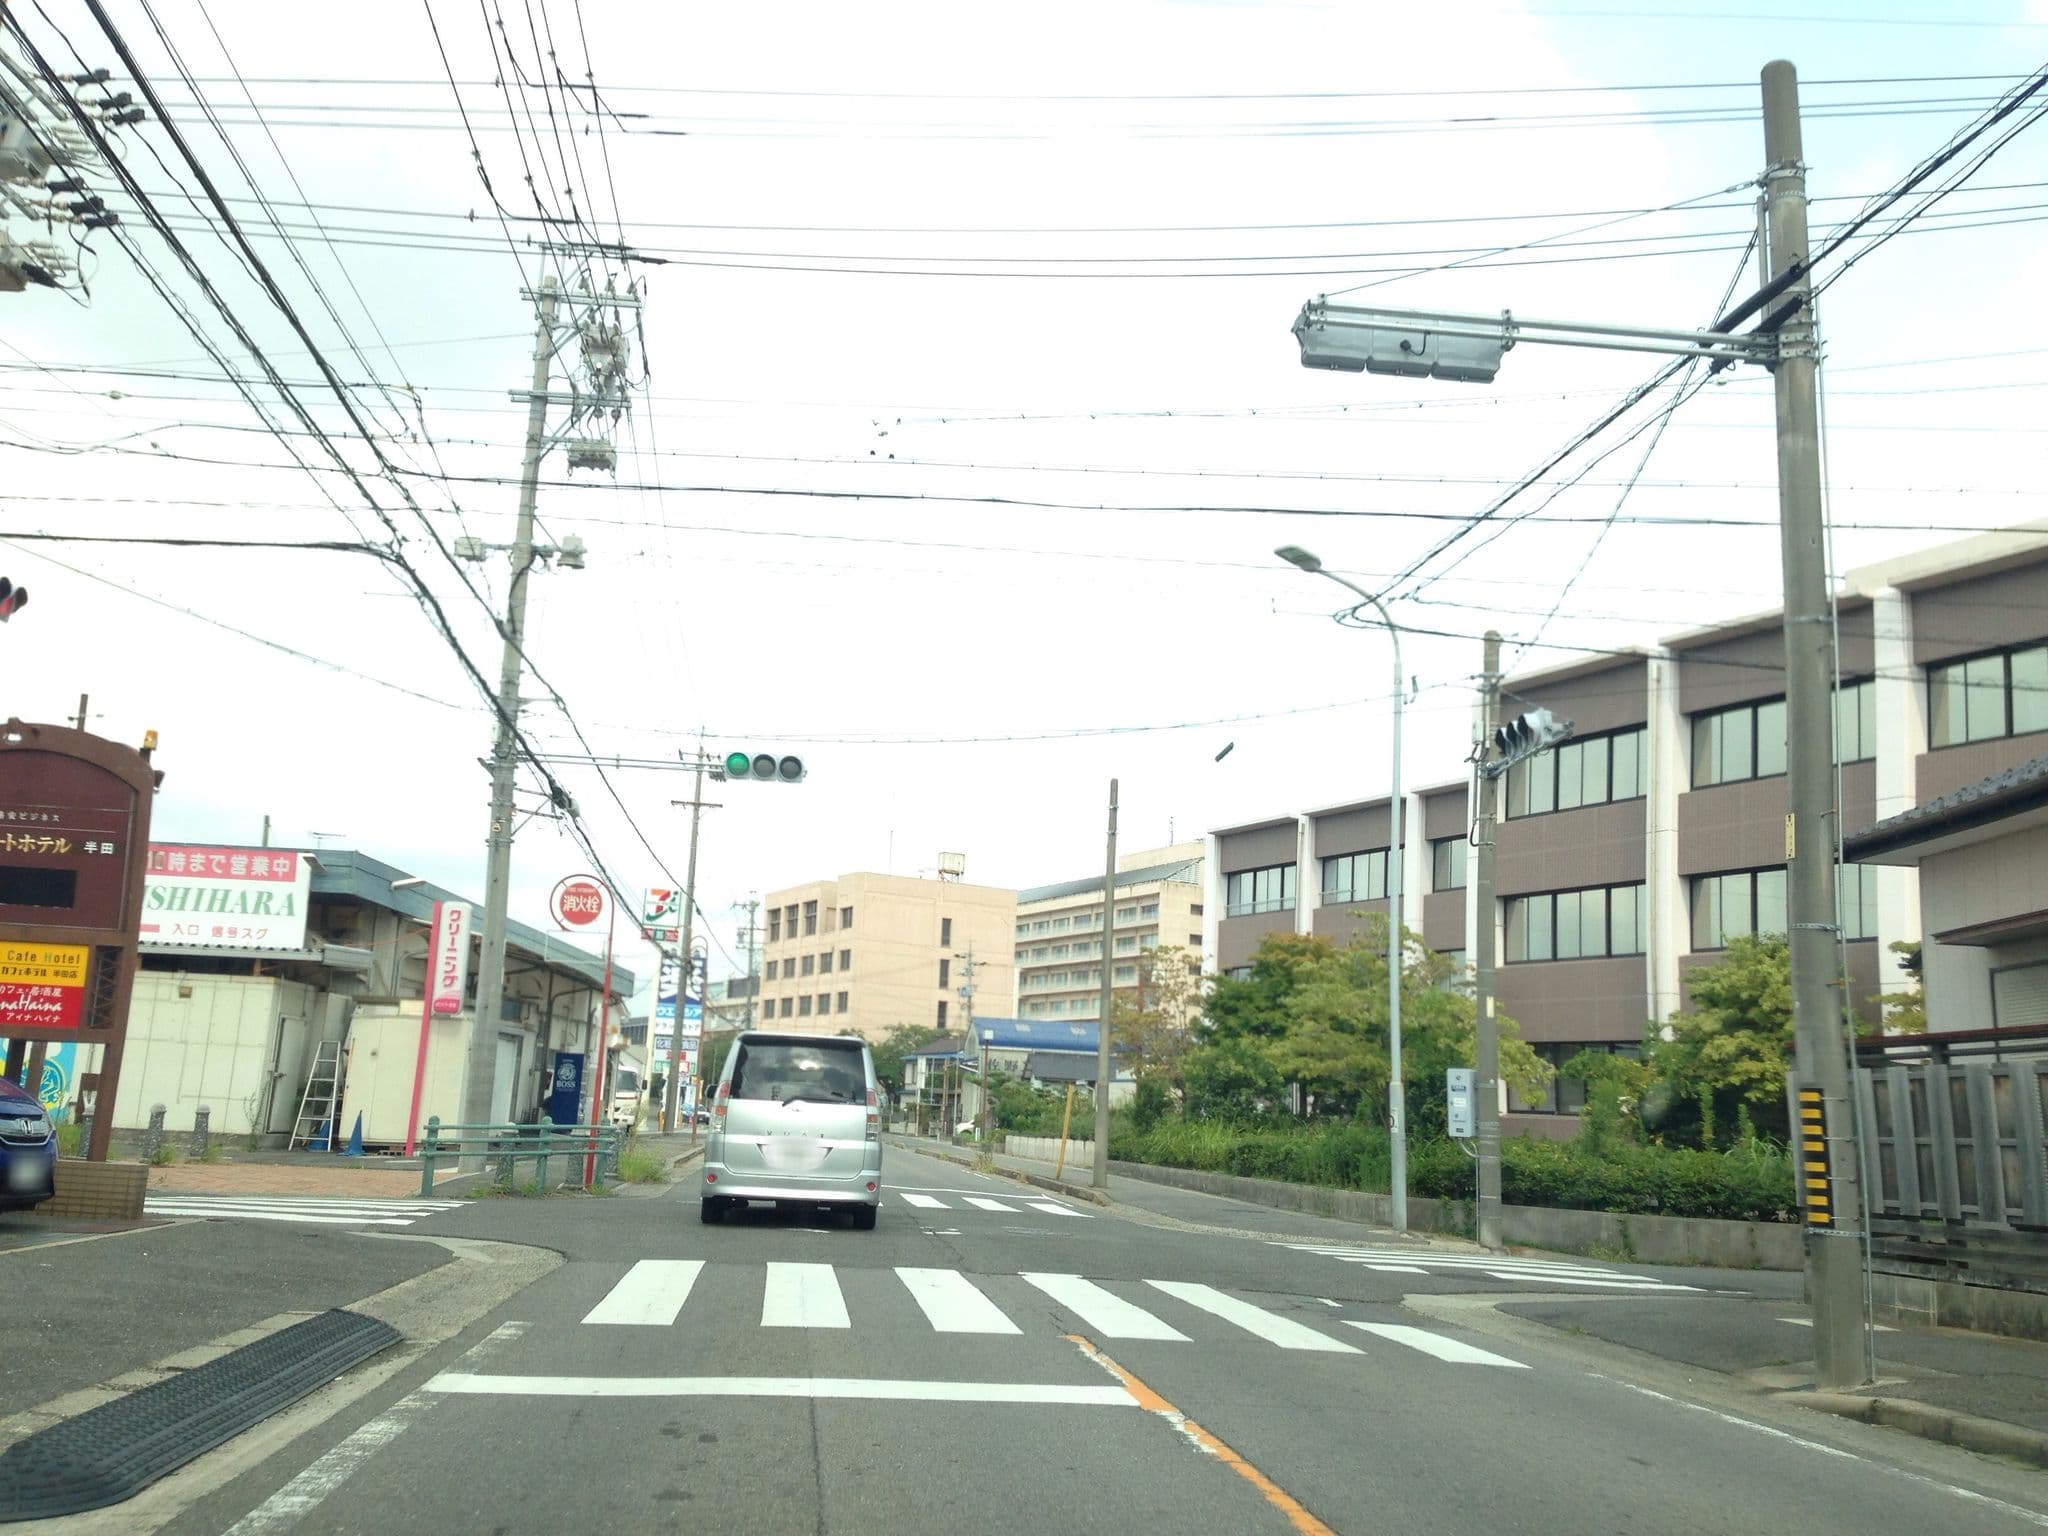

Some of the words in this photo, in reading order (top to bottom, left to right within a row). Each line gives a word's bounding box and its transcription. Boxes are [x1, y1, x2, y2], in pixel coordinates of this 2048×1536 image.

[84, 841, 114, 854] 半田
[563, 895, 600, 913] 消火栓
[172, 924, 200, 936] 入口
[443, 909, 462, 988] クリーニング
[7, 950, 37, 962] Cafe
[45, 952, 80, 965] Hotel
[656, 1006, 702, 1018] ウエシア
